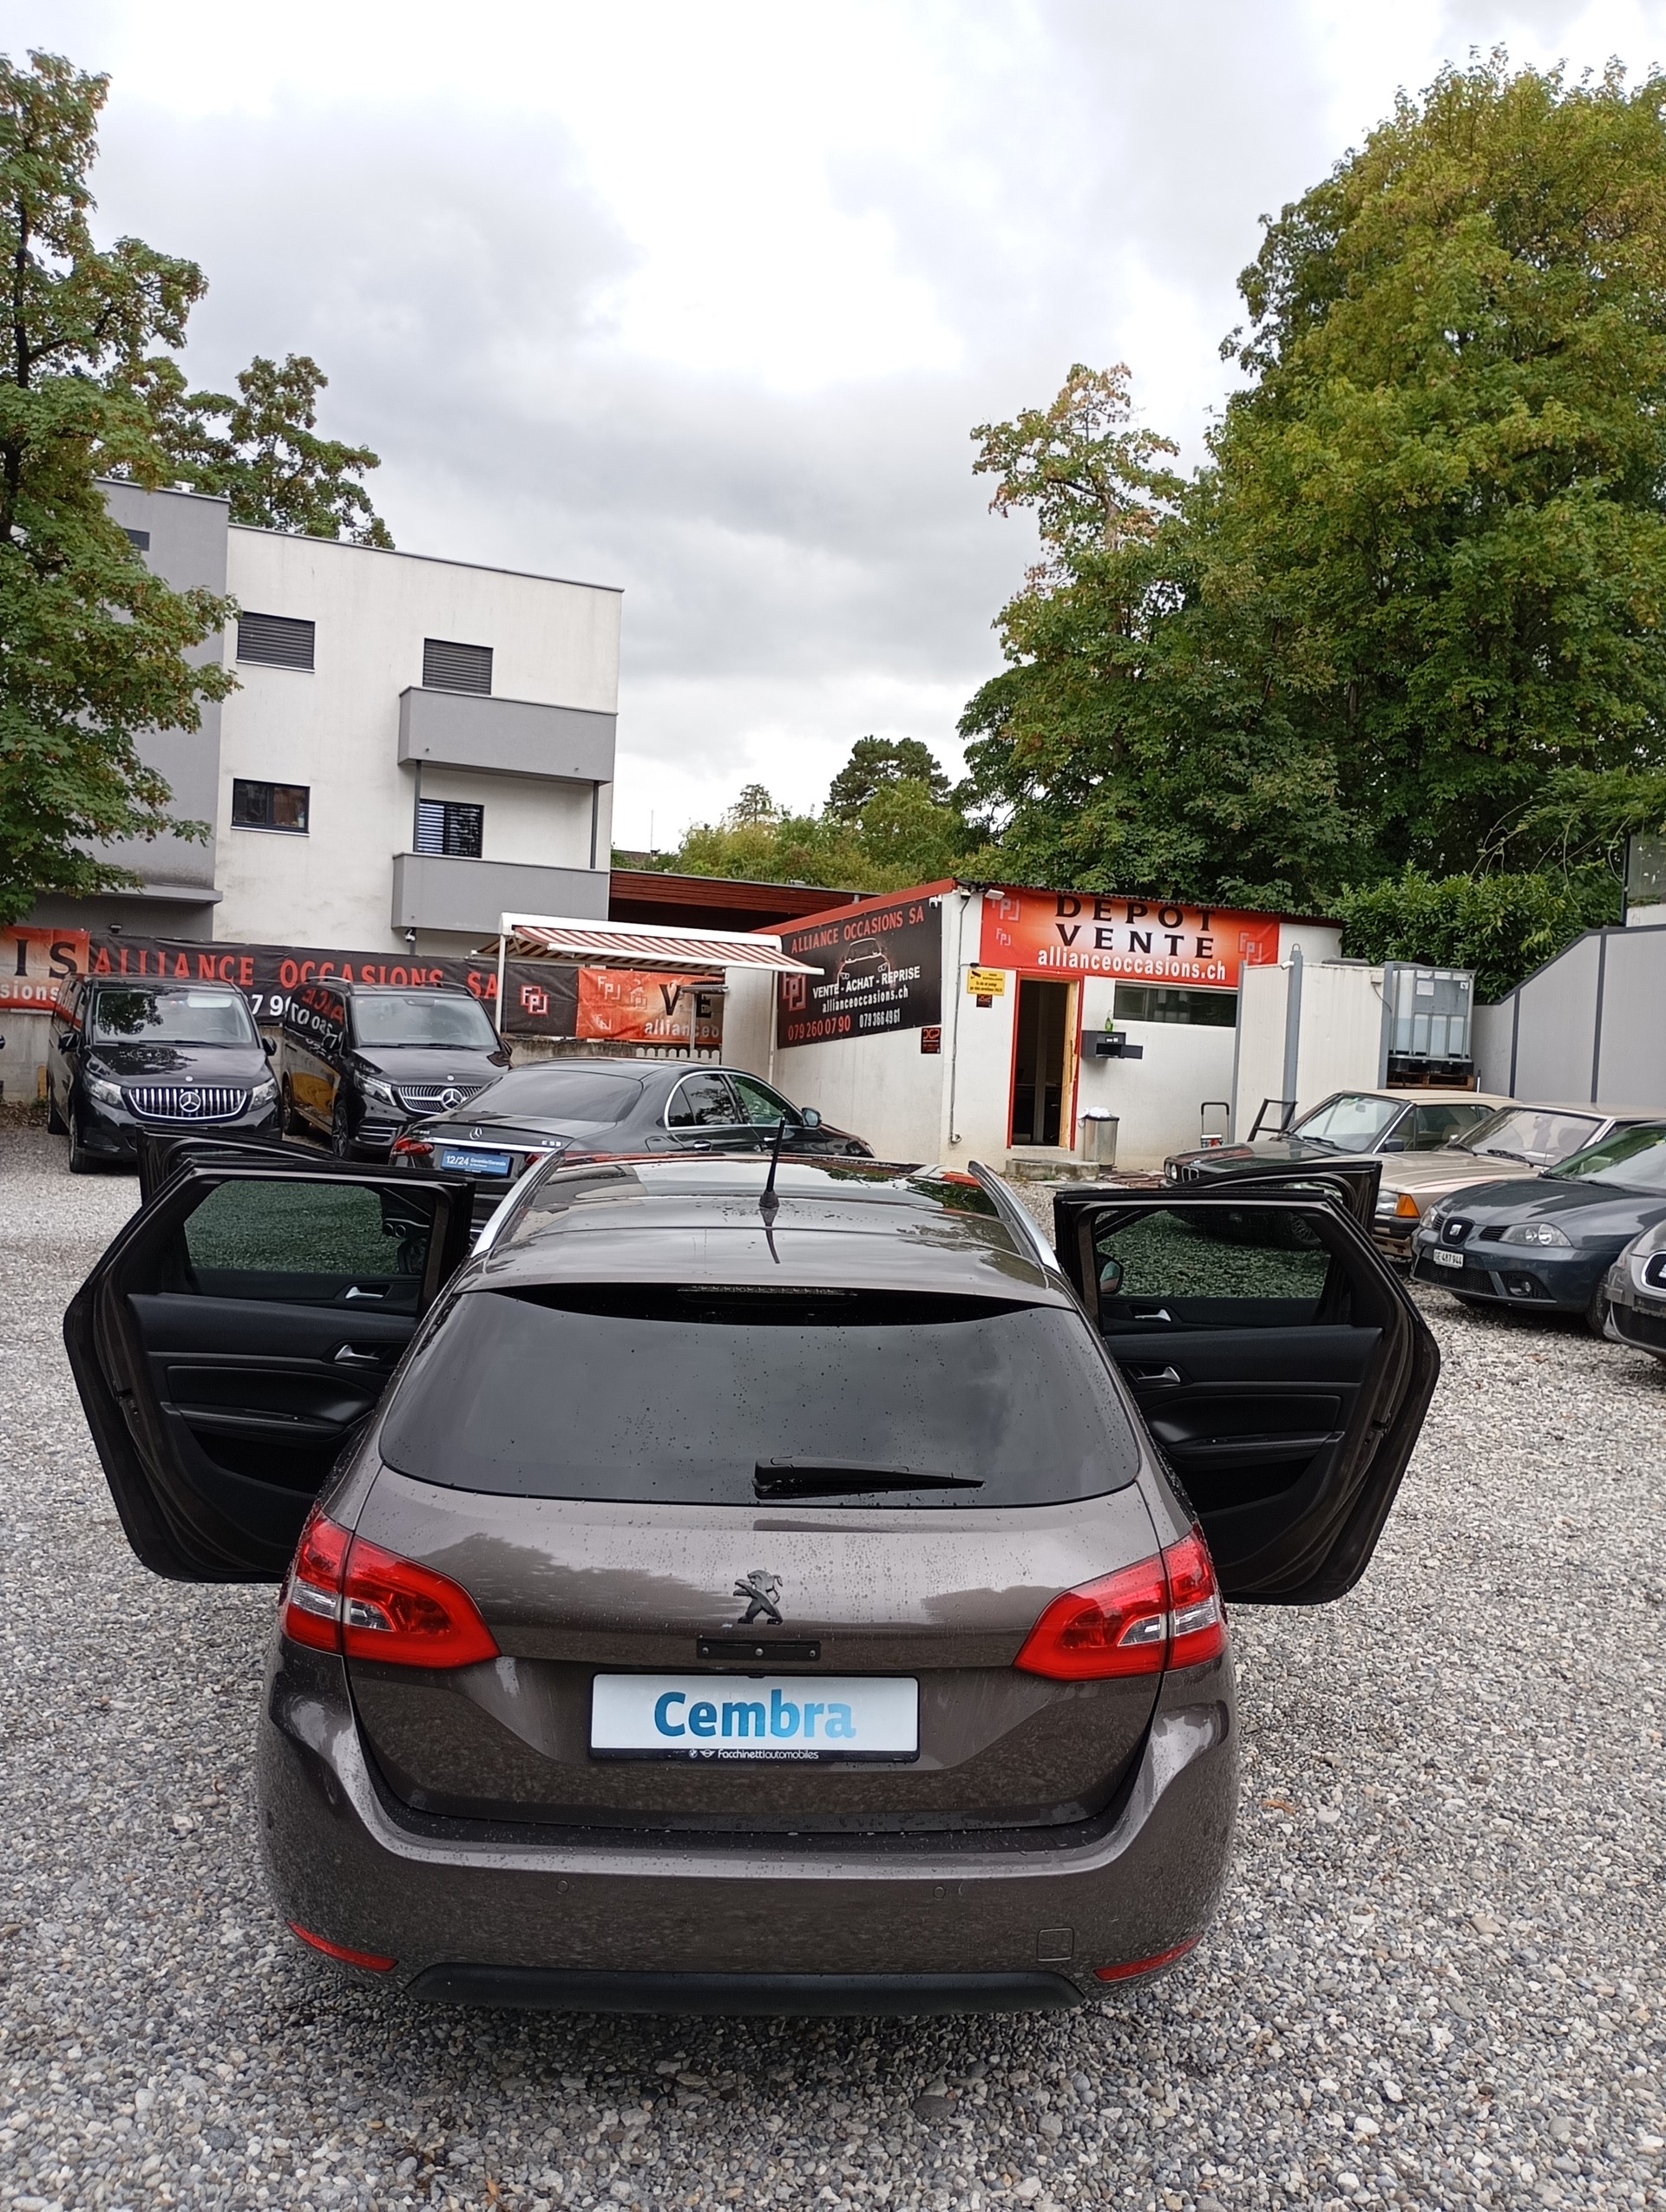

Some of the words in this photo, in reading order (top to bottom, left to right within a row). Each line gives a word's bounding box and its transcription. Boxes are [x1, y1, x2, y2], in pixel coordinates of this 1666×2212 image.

[790, 927, 839, 954] ALLIANCE
[843, 910, 903, 940] OCCASIONS
[908, 905, 924, 925] SA
[1055, 894, 1216, 932] DEPOT
[1055, 923, 1214, 959] VENTE
[1037, 946, 1226, 980] allianceoccasions.ch
[467, 971, 498, 1000] SA
[812, 983, 840, 999] VENTE
[845, 975, 874, 993] ACHAT
[881, 965, 921, 985] REPRISE
[822, 985, 908, 1013] allianceoccasions.ch
[788, 1023, 804, 1041] 079
[806, 1020, 823, 1037] 260
[825, 1018, 836, 1035] 07
[838, 1014, 851, 1033] 90
[859, 1013, 872, 1029] 079
[446, 1155, 469, 1166] 12/24
[653, 1689, 856, 1738] Cembra
